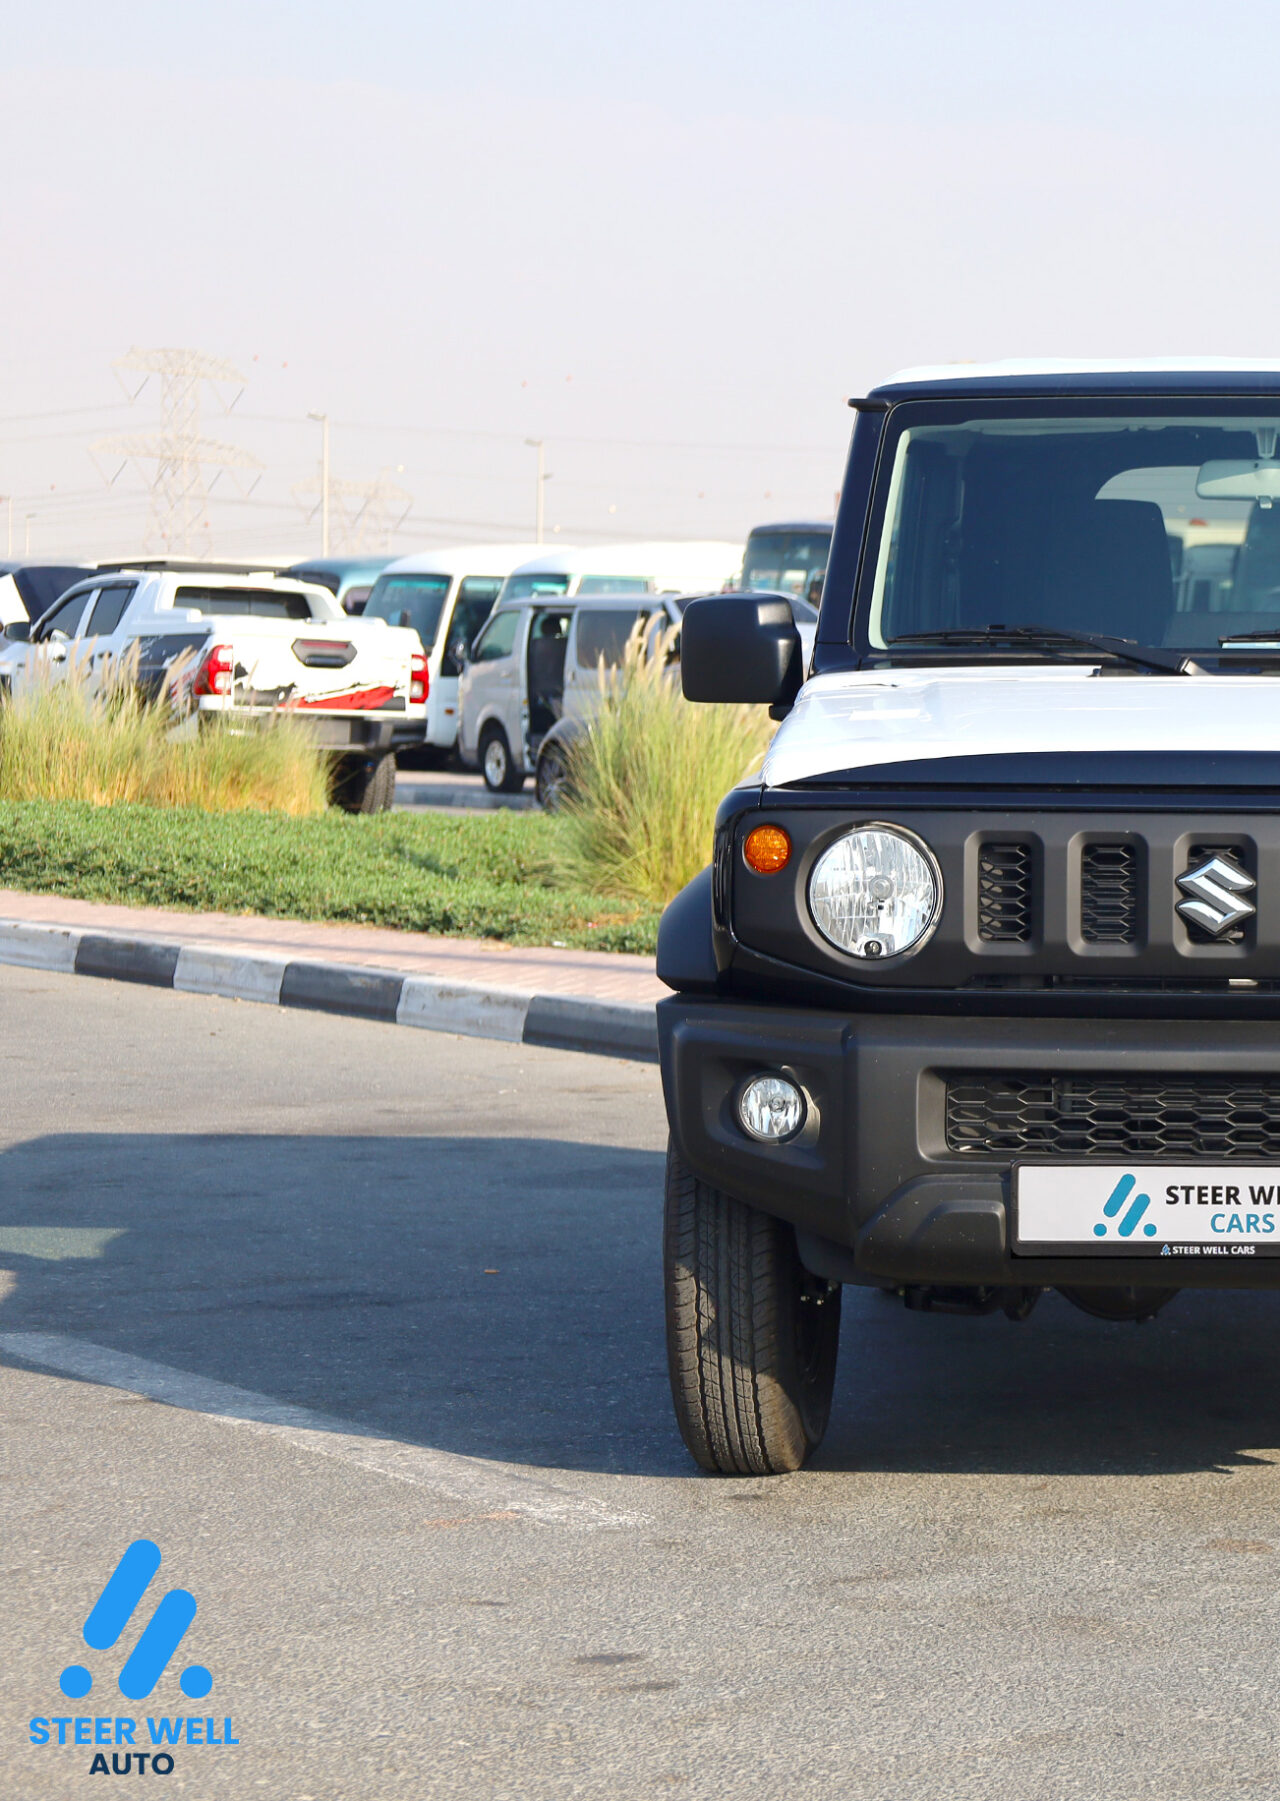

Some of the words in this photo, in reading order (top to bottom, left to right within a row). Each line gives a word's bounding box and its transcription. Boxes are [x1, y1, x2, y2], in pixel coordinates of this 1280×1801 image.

[1165, 1185, 1242, 1206] STEER
[1210, 1213, 1275, 1234] CARS
[1172, 1245, 1200, 1255] STEER
[1202, 1245, 1229, 1255] WELL
[1230, 1245, 1256, 1255] CARS
